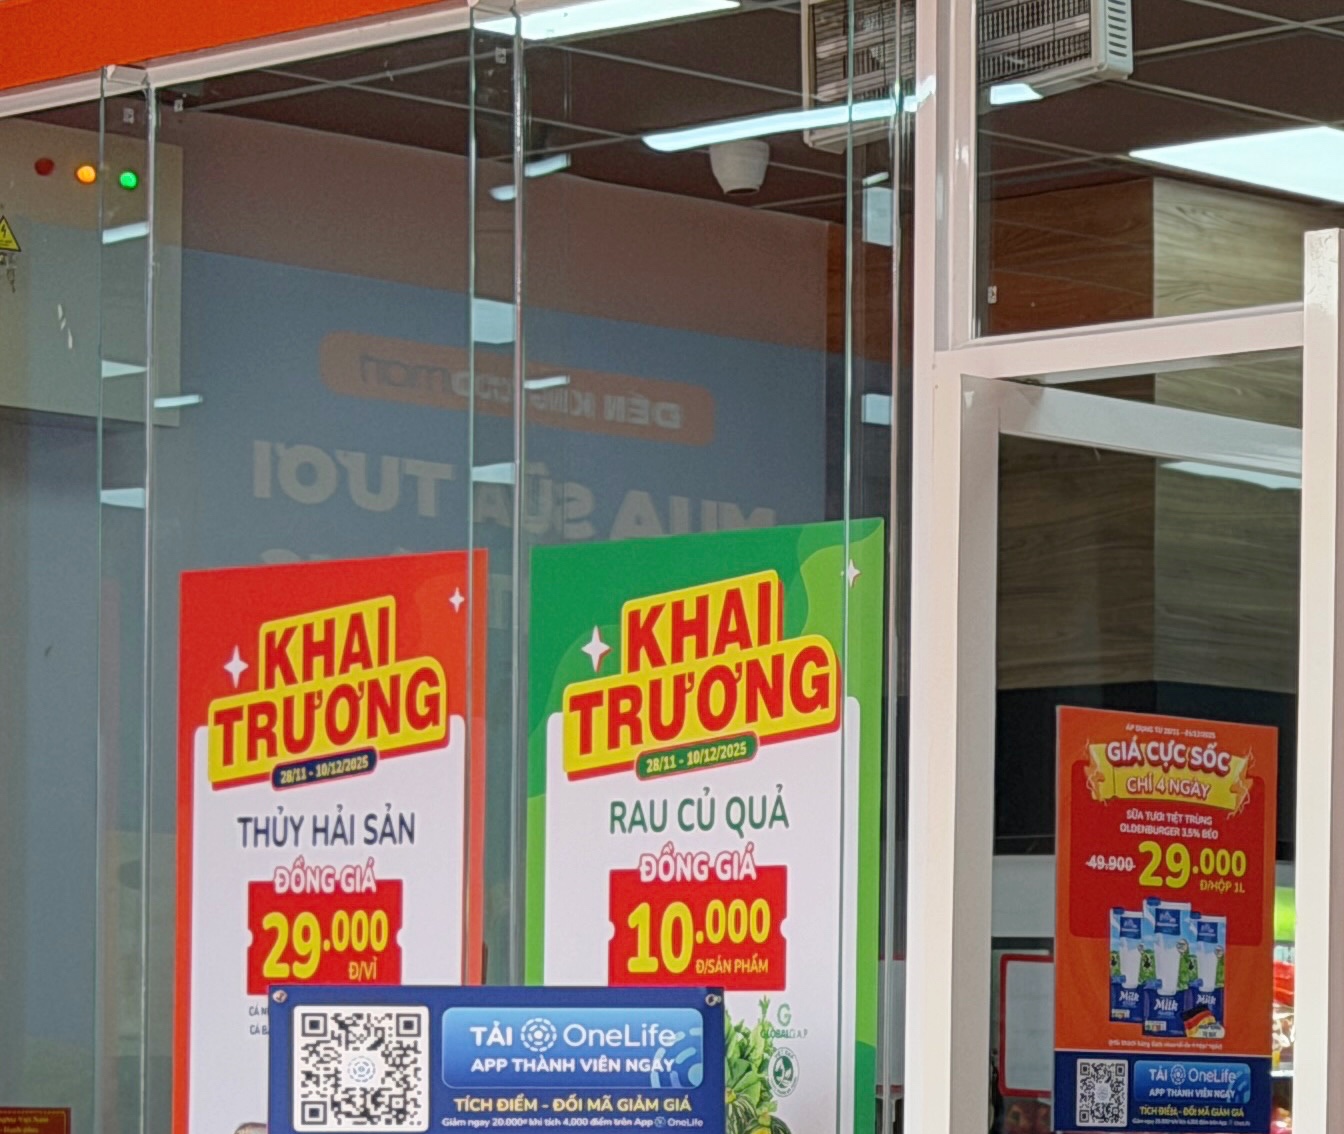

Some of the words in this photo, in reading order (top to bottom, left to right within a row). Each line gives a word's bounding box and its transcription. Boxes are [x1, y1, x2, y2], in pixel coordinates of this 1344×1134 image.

[264, 606, 391, 691] KHAI
[627, 580, 772, 674] KHAI
[213, 666, 441, 767] TRƯƠNG
[568, 645, 830, 756] TRƯƠNG
[280, 767, 307, 784] 28/11
[315, 755, 369, 779] 10/12/2025
[646, 755, 676, 774] 28/11
[687, 741, 747, 767] 10/12/2025
[236, 805, 305, 849] THỦY
[312, 804, 355, 847] HẢI
[363, 802, 415, 845] SẢN
[610, 798, 667, 835] RAU
[677, 786, 715, 832] CỦ
[725, 783, 789, 839] QUẢ
[273, 855, 335, 895] ĐỒNG
[340, 855, 377, 893] GIÁ
[640, 841, 710, 883] ĐỒNG
[715, 842, 757, 881] GIÁ
[1138, 840, 1247, 889] 29.000
[261, 909, 389, 980] 29.000
[627, 898, 770, 974] 10.000
[469, 1021, 513, 1046] TẢI
[563, 1023, 676, 1047] OneLife
[471, 1058, 508, 1072] APP
[512, 1054, 575, 1072] THÀNH
[580, 1054, 623, 1072] VIÊN
[626, 1058, 675, 1073] NGAY
[453, 1095, 493, 1112] TÍCH
[496, 1094, 538, 1112] ĐIỂM
[552, 1094, 583, 1112] ĐỔI
[587, 1095, 614, 1111] MÃ
[617, 1095, 660, 1111] GIẢM
[663, 1095, 692, 1111] GIÁ
